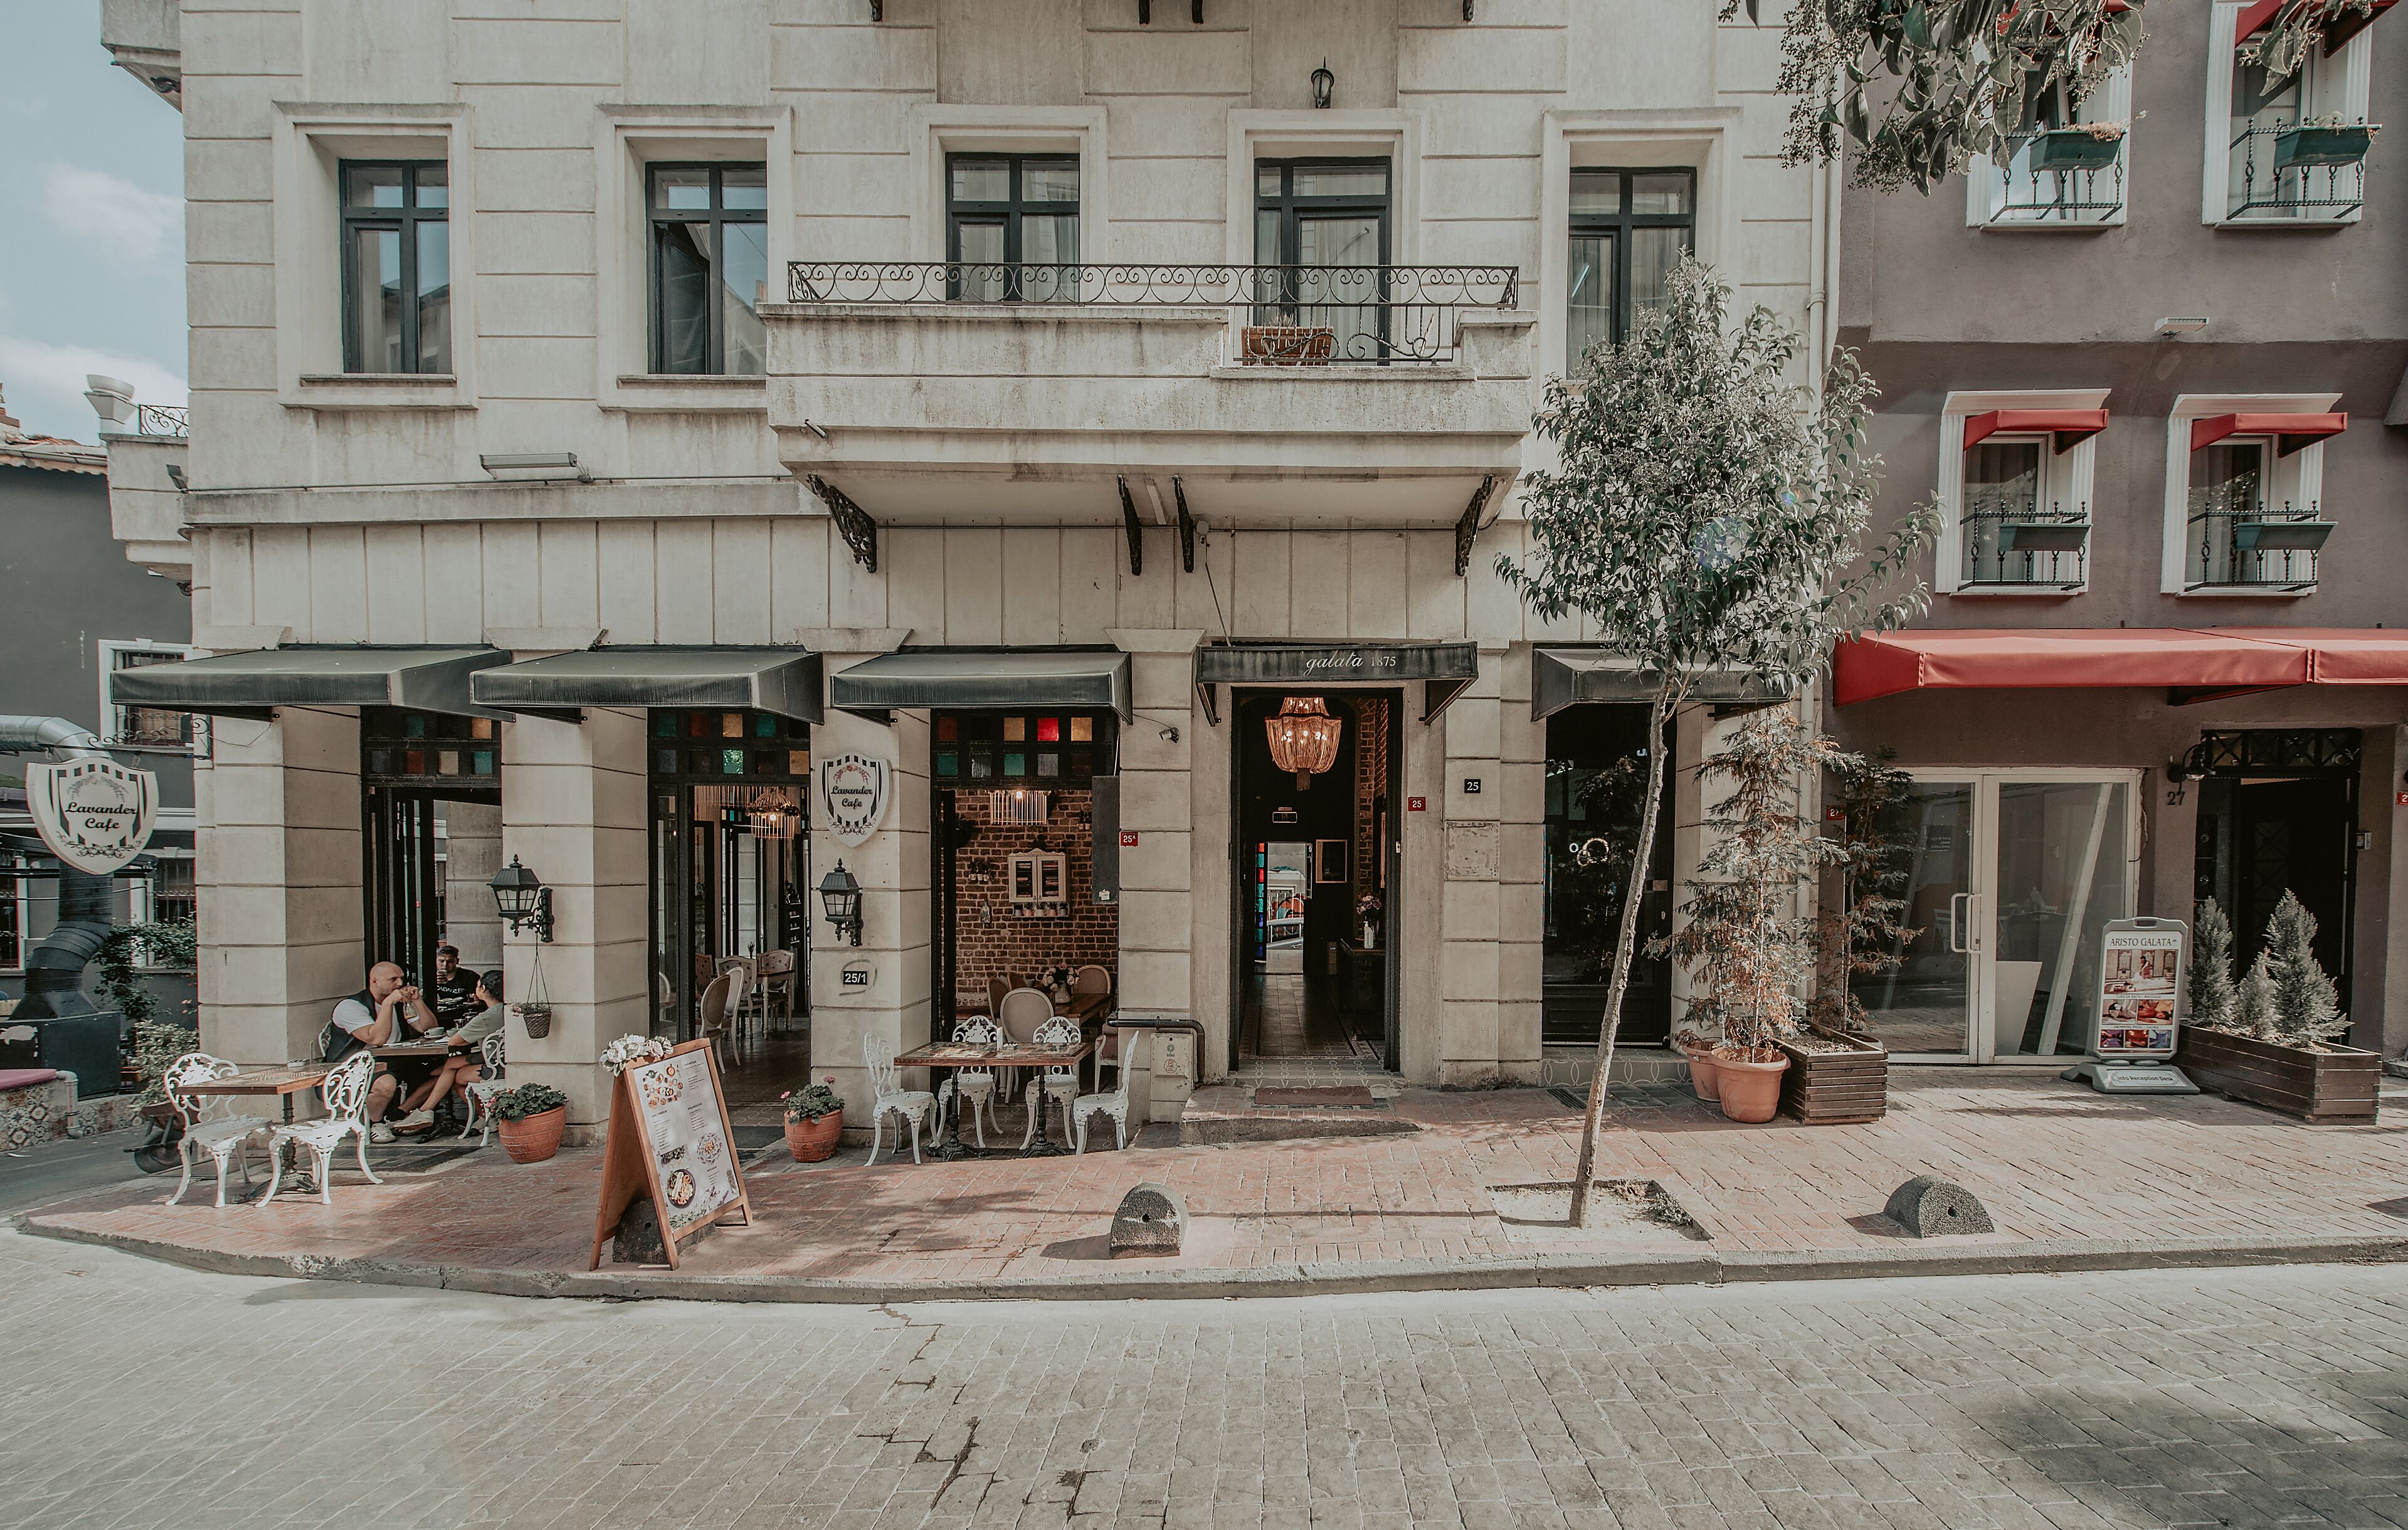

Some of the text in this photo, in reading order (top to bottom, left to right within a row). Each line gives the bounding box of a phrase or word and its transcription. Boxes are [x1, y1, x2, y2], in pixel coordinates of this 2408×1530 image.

[1303, 650, 1396, 677] galata 1875
[830, 785, 872, 795] Lavander
[1467, 781, 1479, 791] 25
[2167, 791, 2185, 806] 27
[65, 801, 137, 815] Lavander
[842, 798, 862, 810] Cafe
[1412, 800, 1422, 808] 25
[85, 818, 120, 832] Cafe
[1123, 835, 1136, 843] 25A
[2110, 938, 2172, 946] ARISTO GALATA
[845, 973, 866, 983] 25/1
